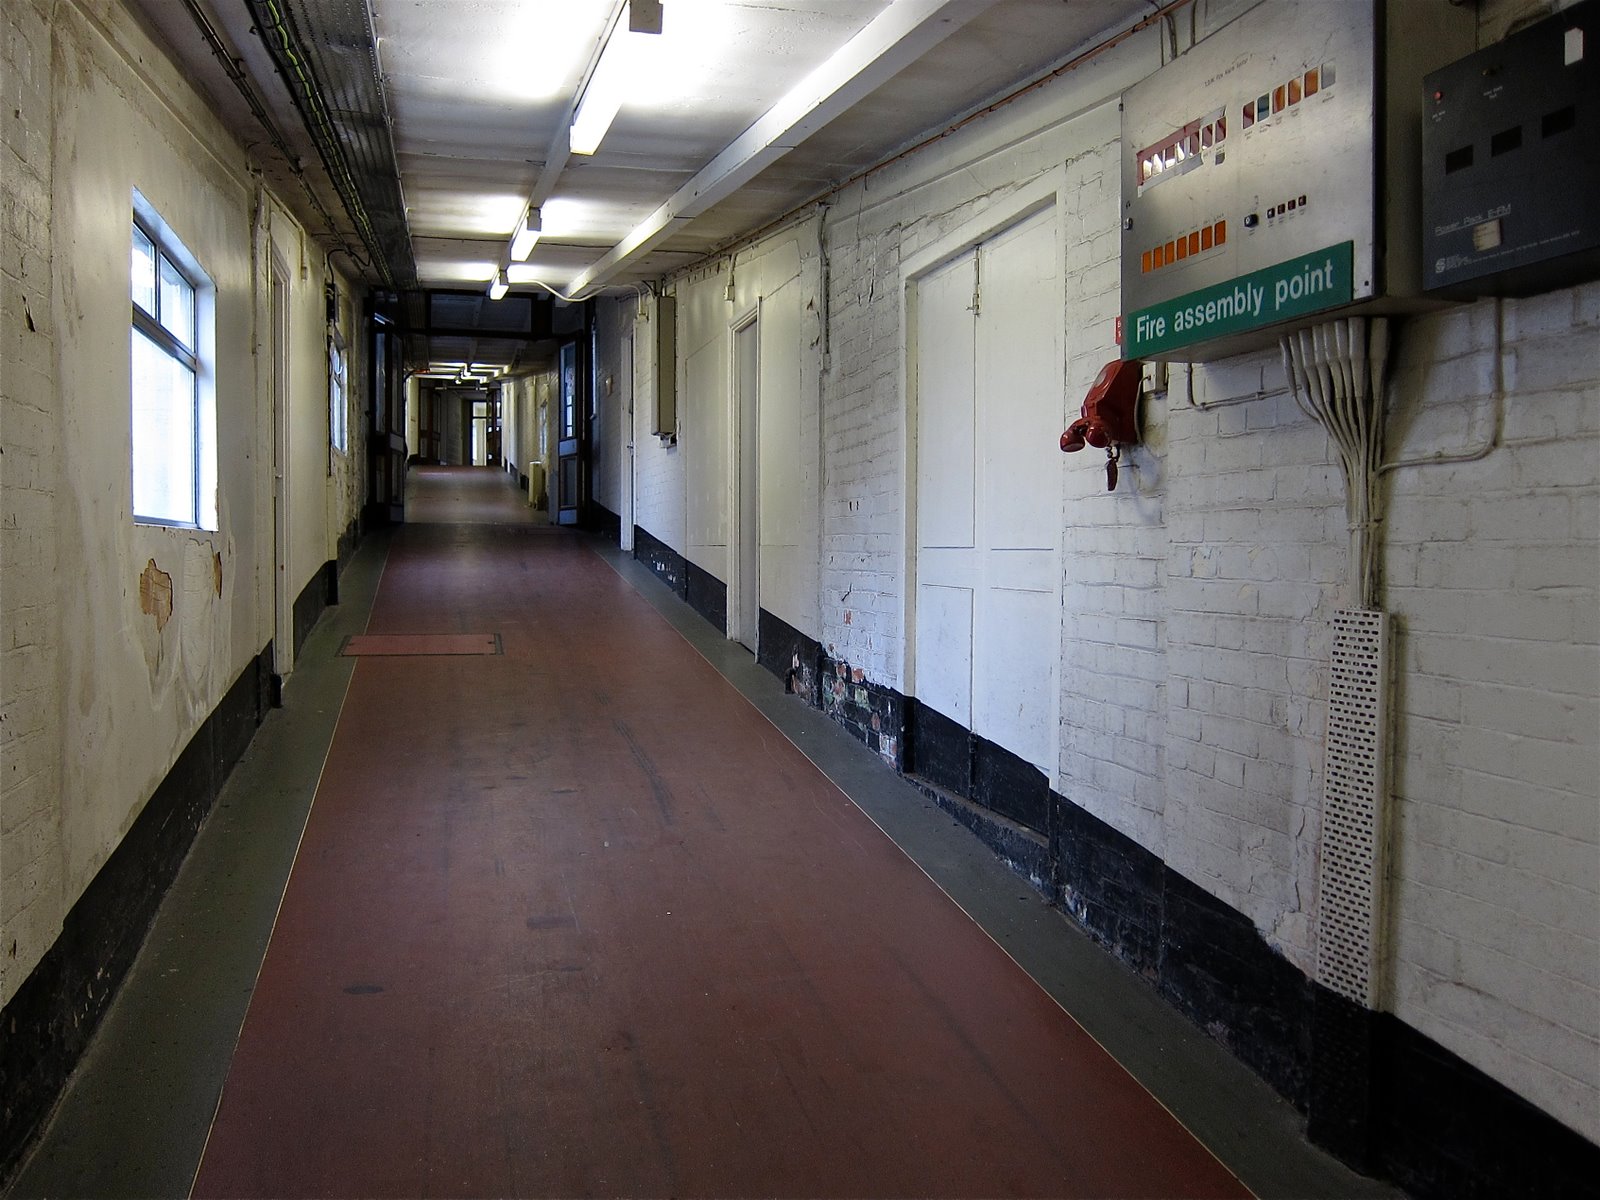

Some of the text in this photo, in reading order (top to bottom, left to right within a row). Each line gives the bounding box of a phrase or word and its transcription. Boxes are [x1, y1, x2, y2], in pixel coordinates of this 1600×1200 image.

[1136, 258, 1333, 343] Fire assembly point
